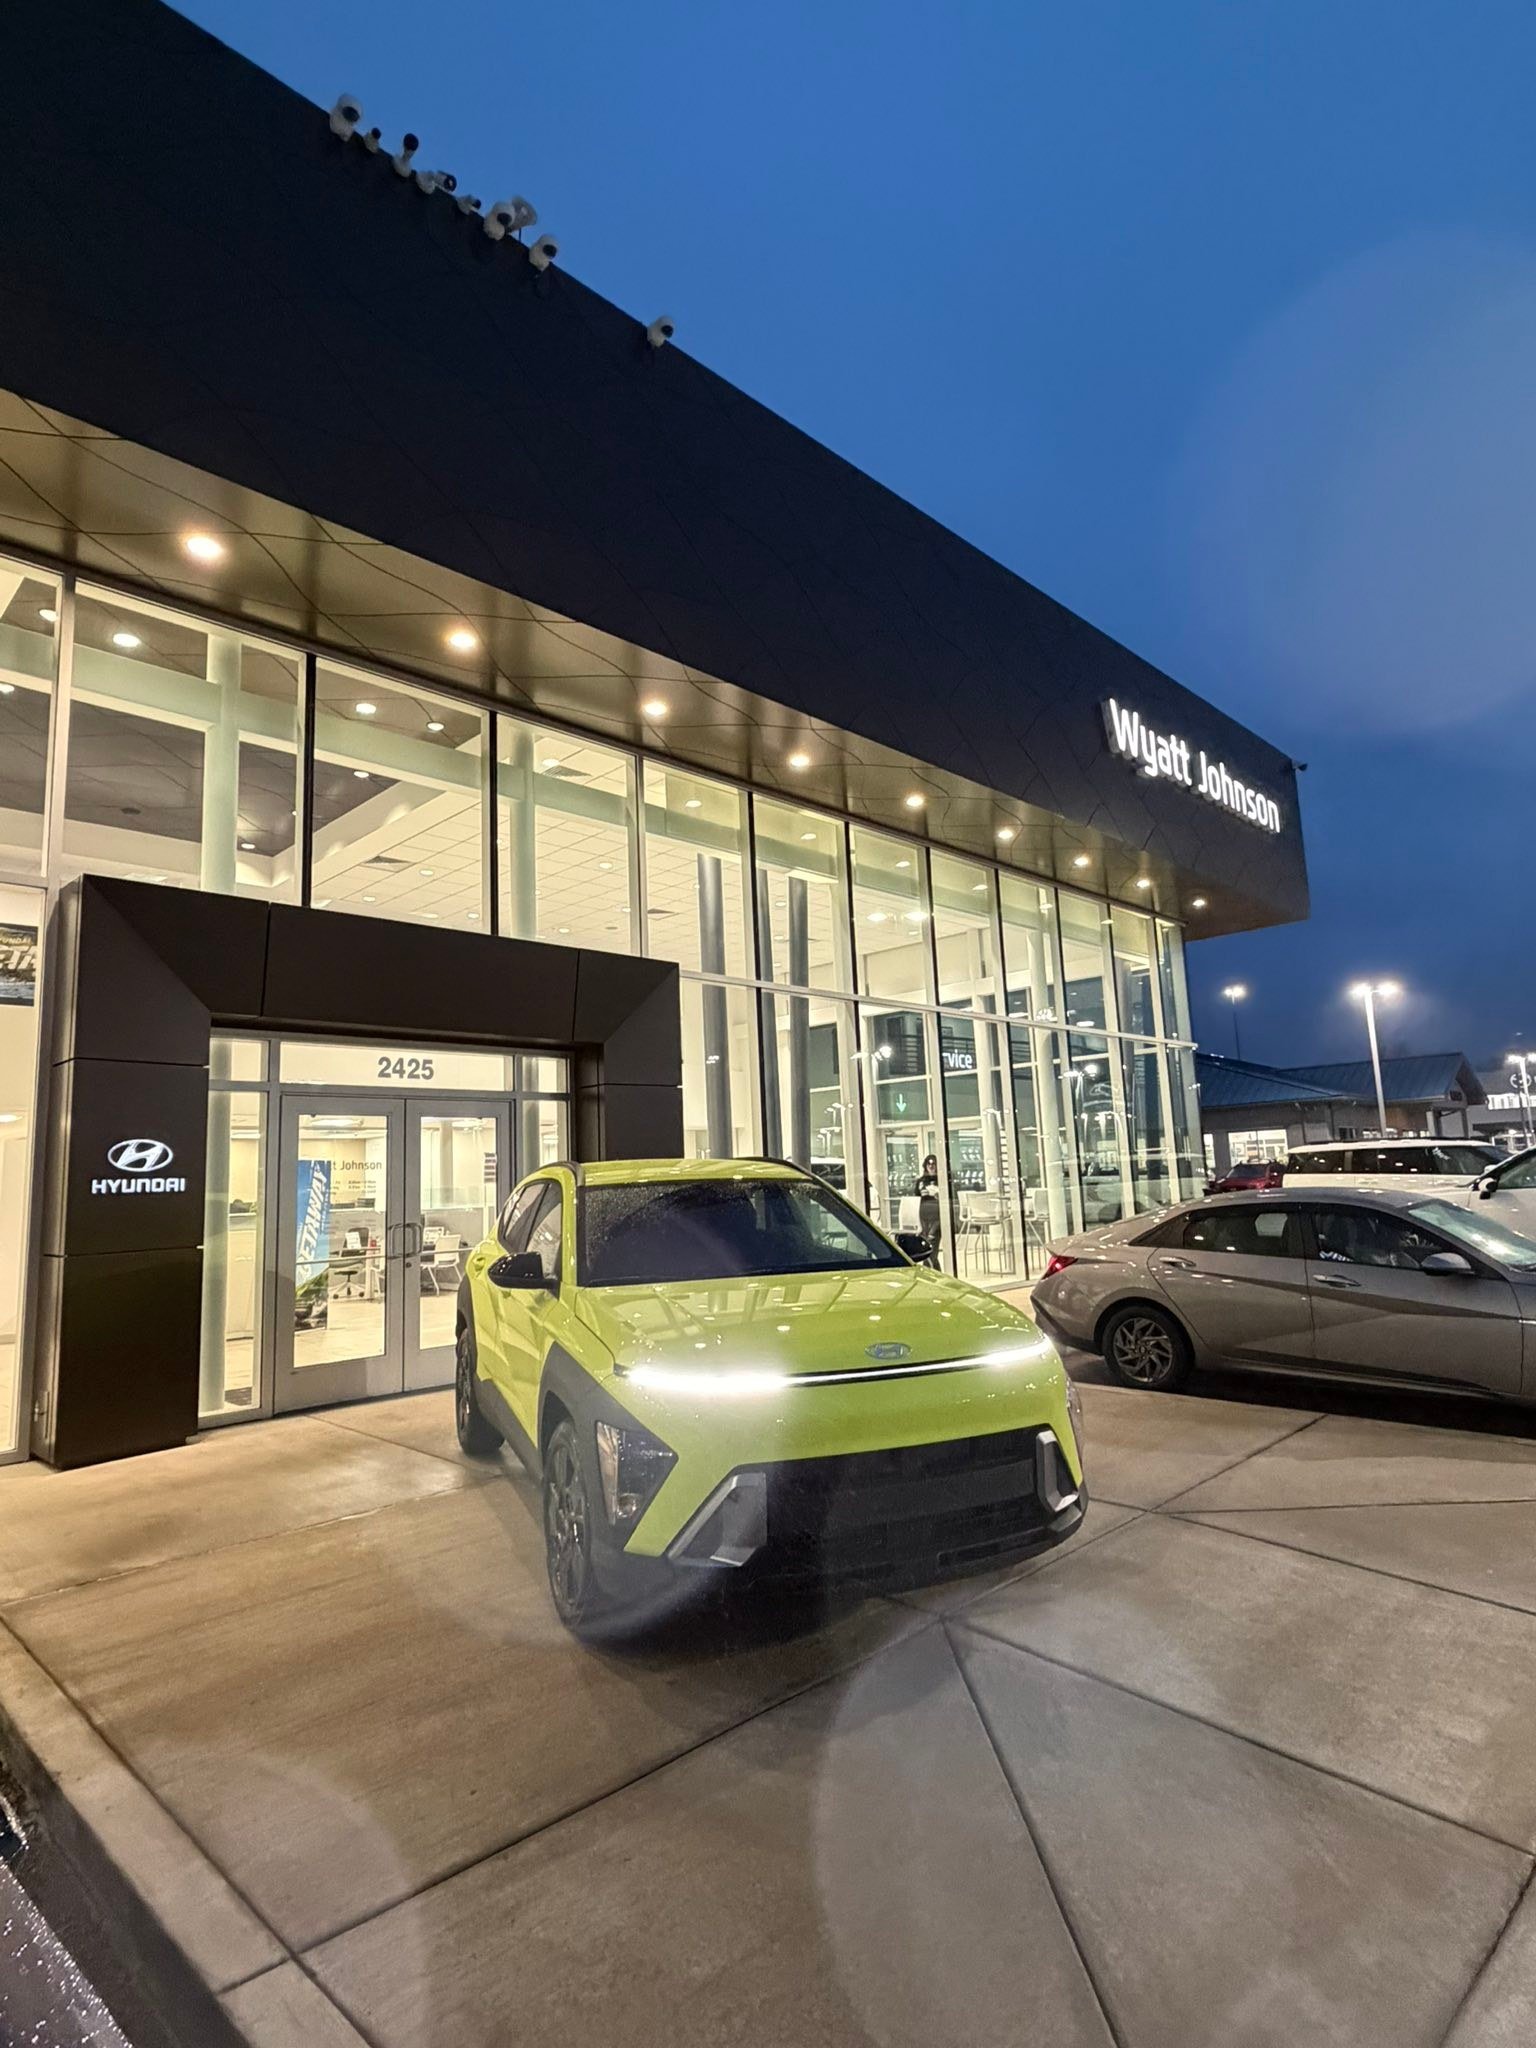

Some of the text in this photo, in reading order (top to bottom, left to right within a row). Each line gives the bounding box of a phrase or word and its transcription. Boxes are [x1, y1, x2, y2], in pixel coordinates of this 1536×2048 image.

[1109, 697, 1281, 834] Wyatt Johnson
[377, 1056, 434, 1080] 2425
[340, 1160, 382, 1171] Johnson
[91, 1177, 185, 1194] HYUNDAI
